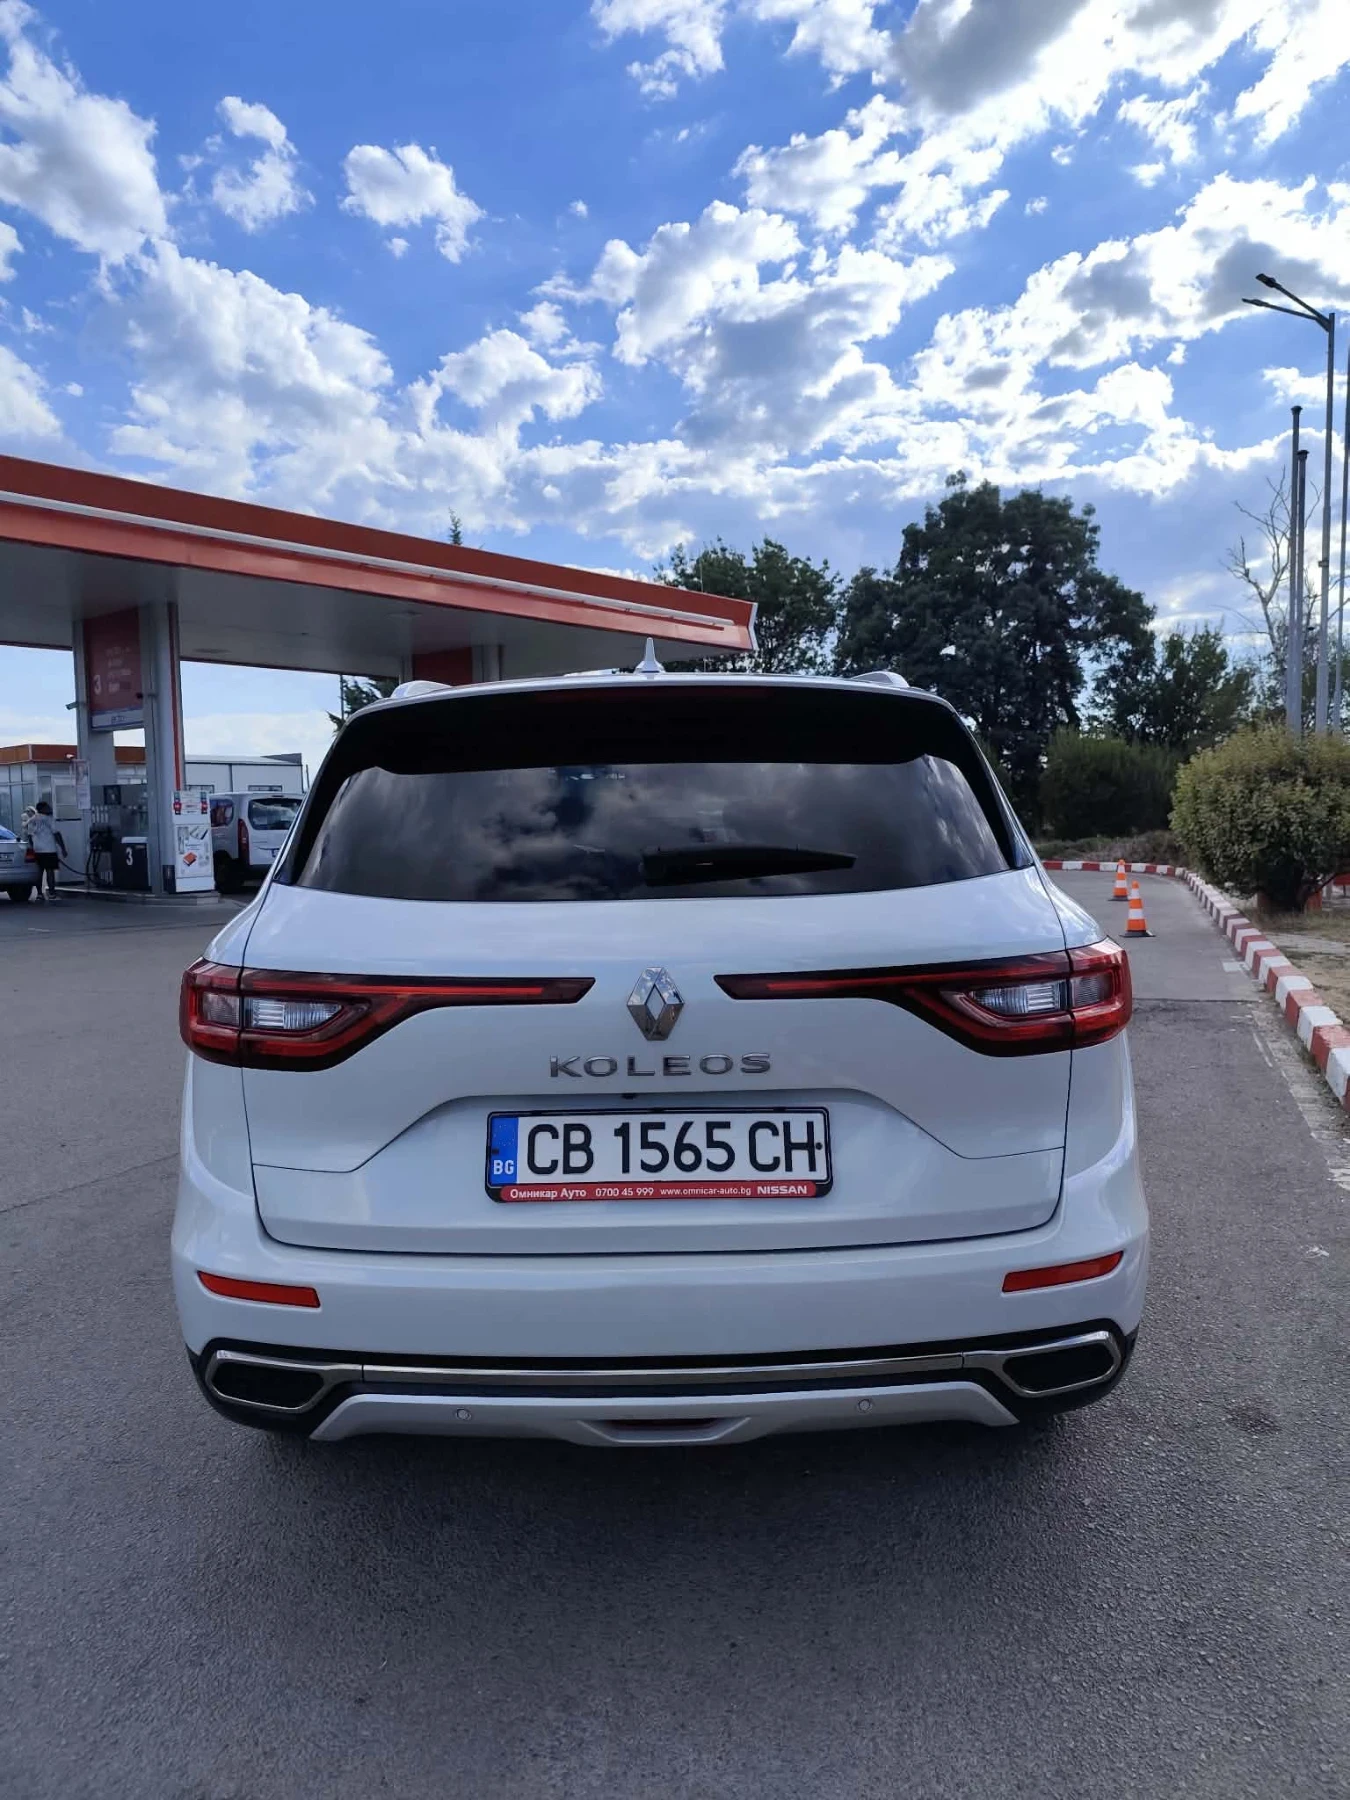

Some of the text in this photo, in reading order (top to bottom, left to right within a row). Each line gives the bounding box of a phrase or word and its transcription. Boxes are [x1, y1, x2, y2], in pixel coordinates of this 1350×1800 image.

[93, 674, 102, 695] 3
[125, 847, 133, 866] 3
[550, 1053, 771, 1078] KOLEOS
[527, 1120, 817, 1175] CB 1565 CH
[493, 1160, 515, 1176] BG
[510, 1185, 808, 1200] Омникар Ауто 0700 45 999 www.omnicar-auto.bg NISSAN
